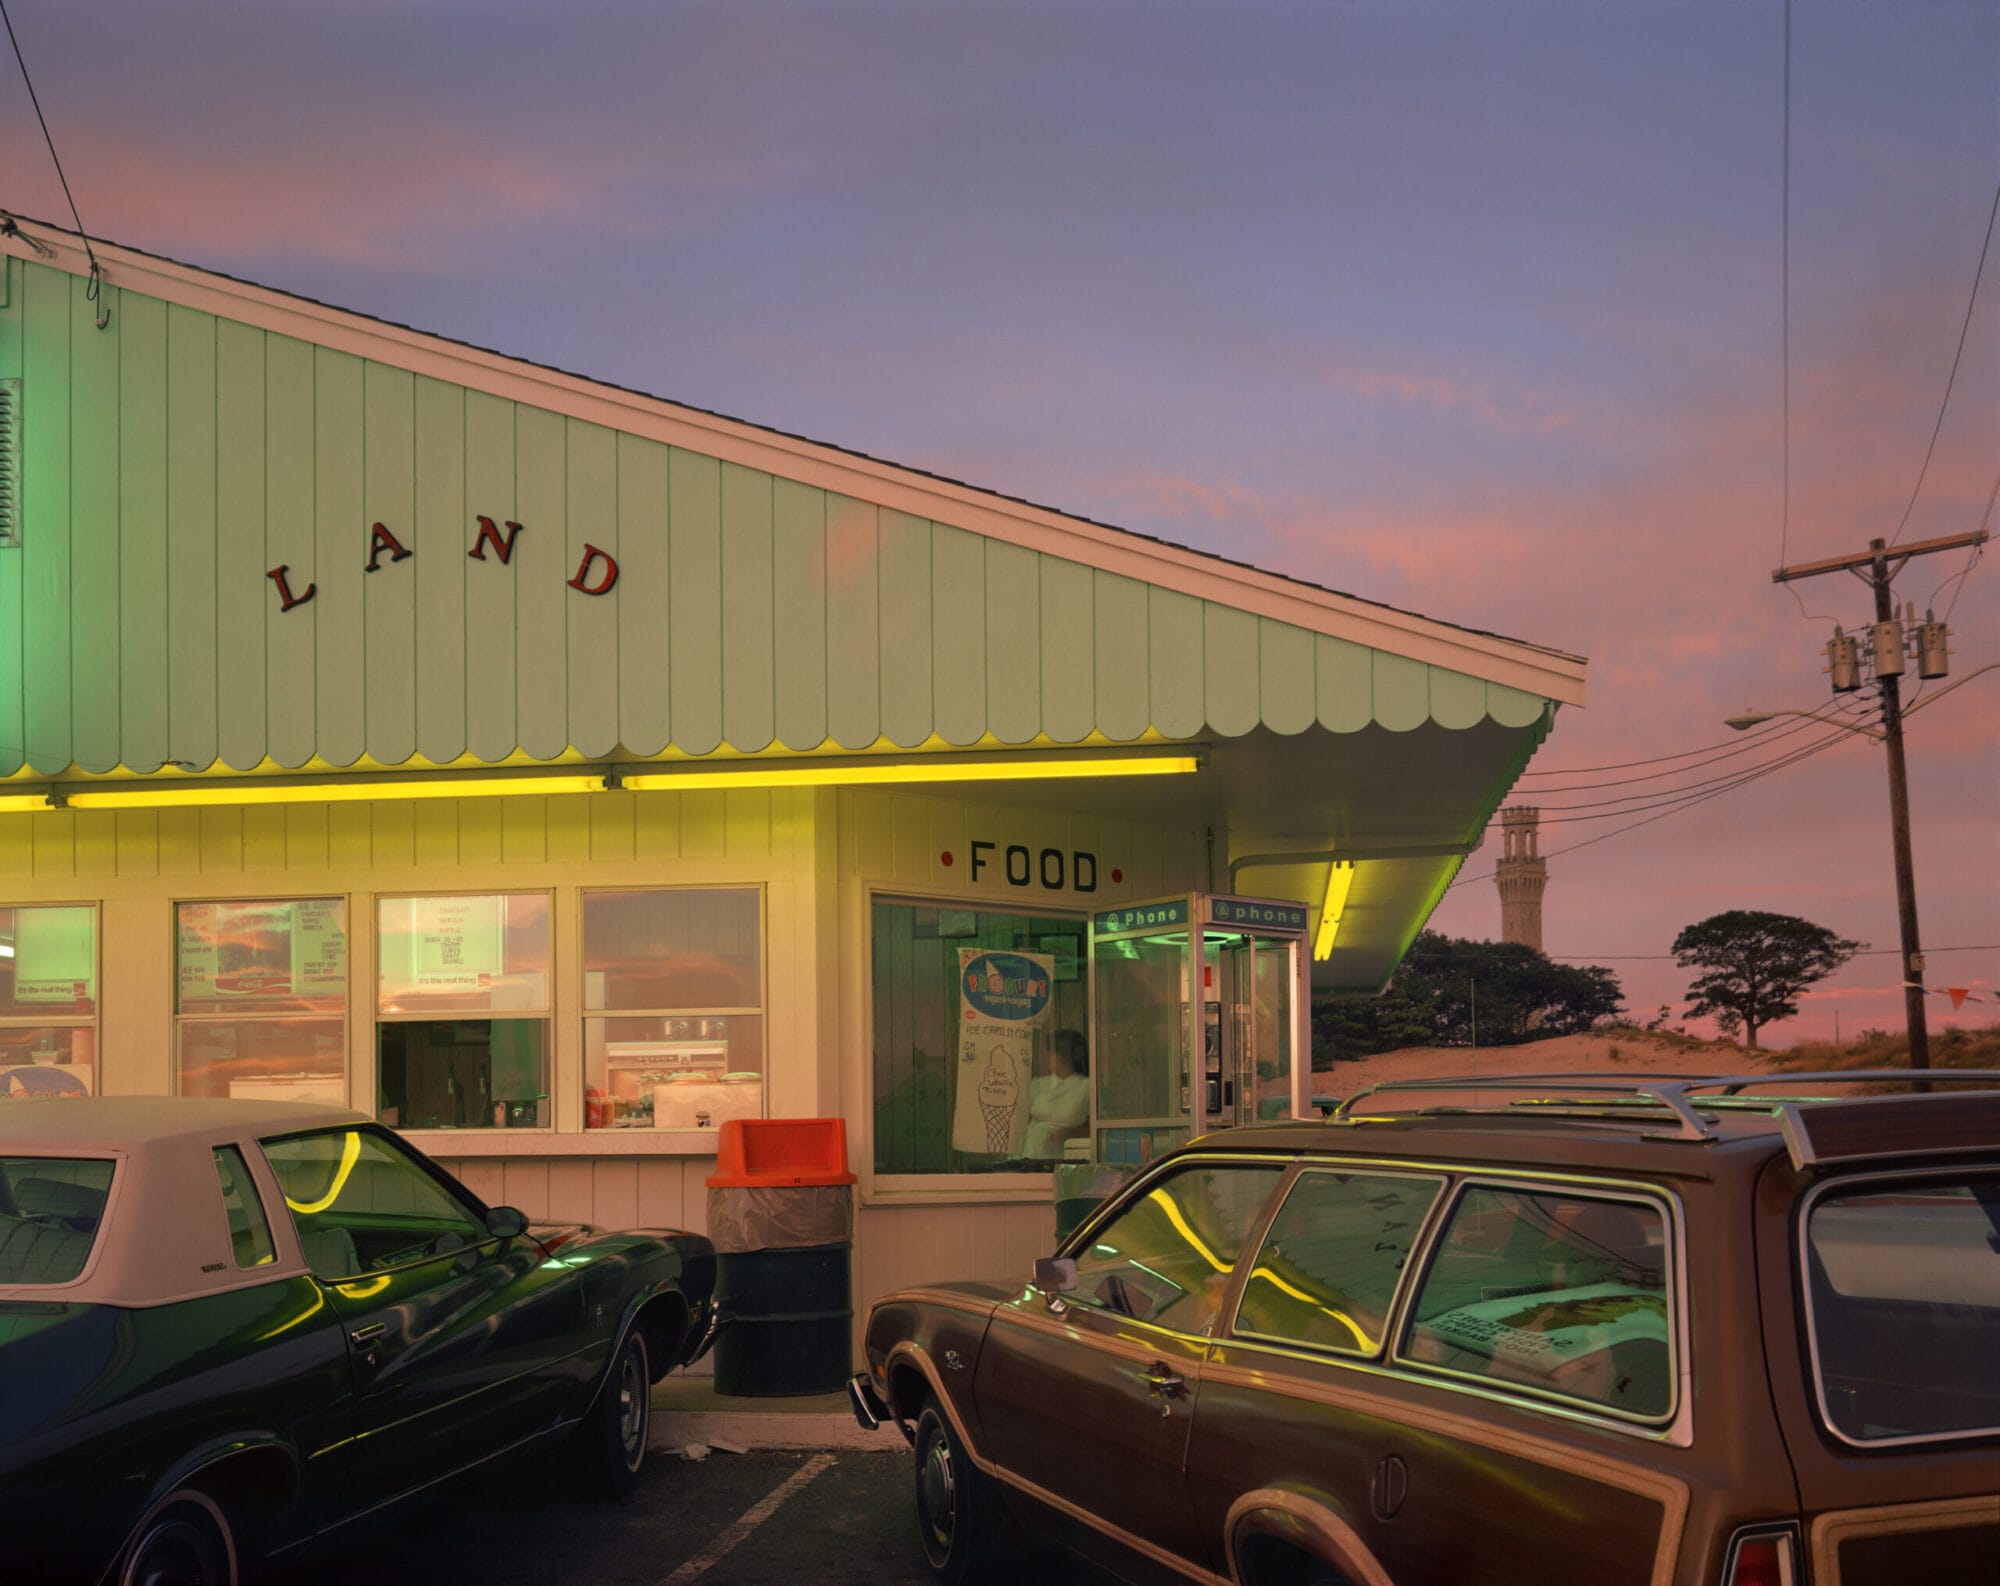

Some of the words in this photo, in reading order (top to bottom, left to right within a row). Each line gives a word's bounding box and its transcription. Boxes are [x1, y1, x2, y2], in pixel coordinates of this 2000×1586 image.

[970, 840, 1097, 892] FOOD
[1235, 905, 1301, 924] phone
[430, 976, 443, 984] the
[443, 976, 458, 984] real
[458, 976, 477, 985] thing
[968, 973, 1047, 998] FROGURT
[28, 985, 40, 993] the
[40, 985, 54, 993] real
[53, 985, 72, 994] thing
[966, 1025, 980, 1035] ICE
